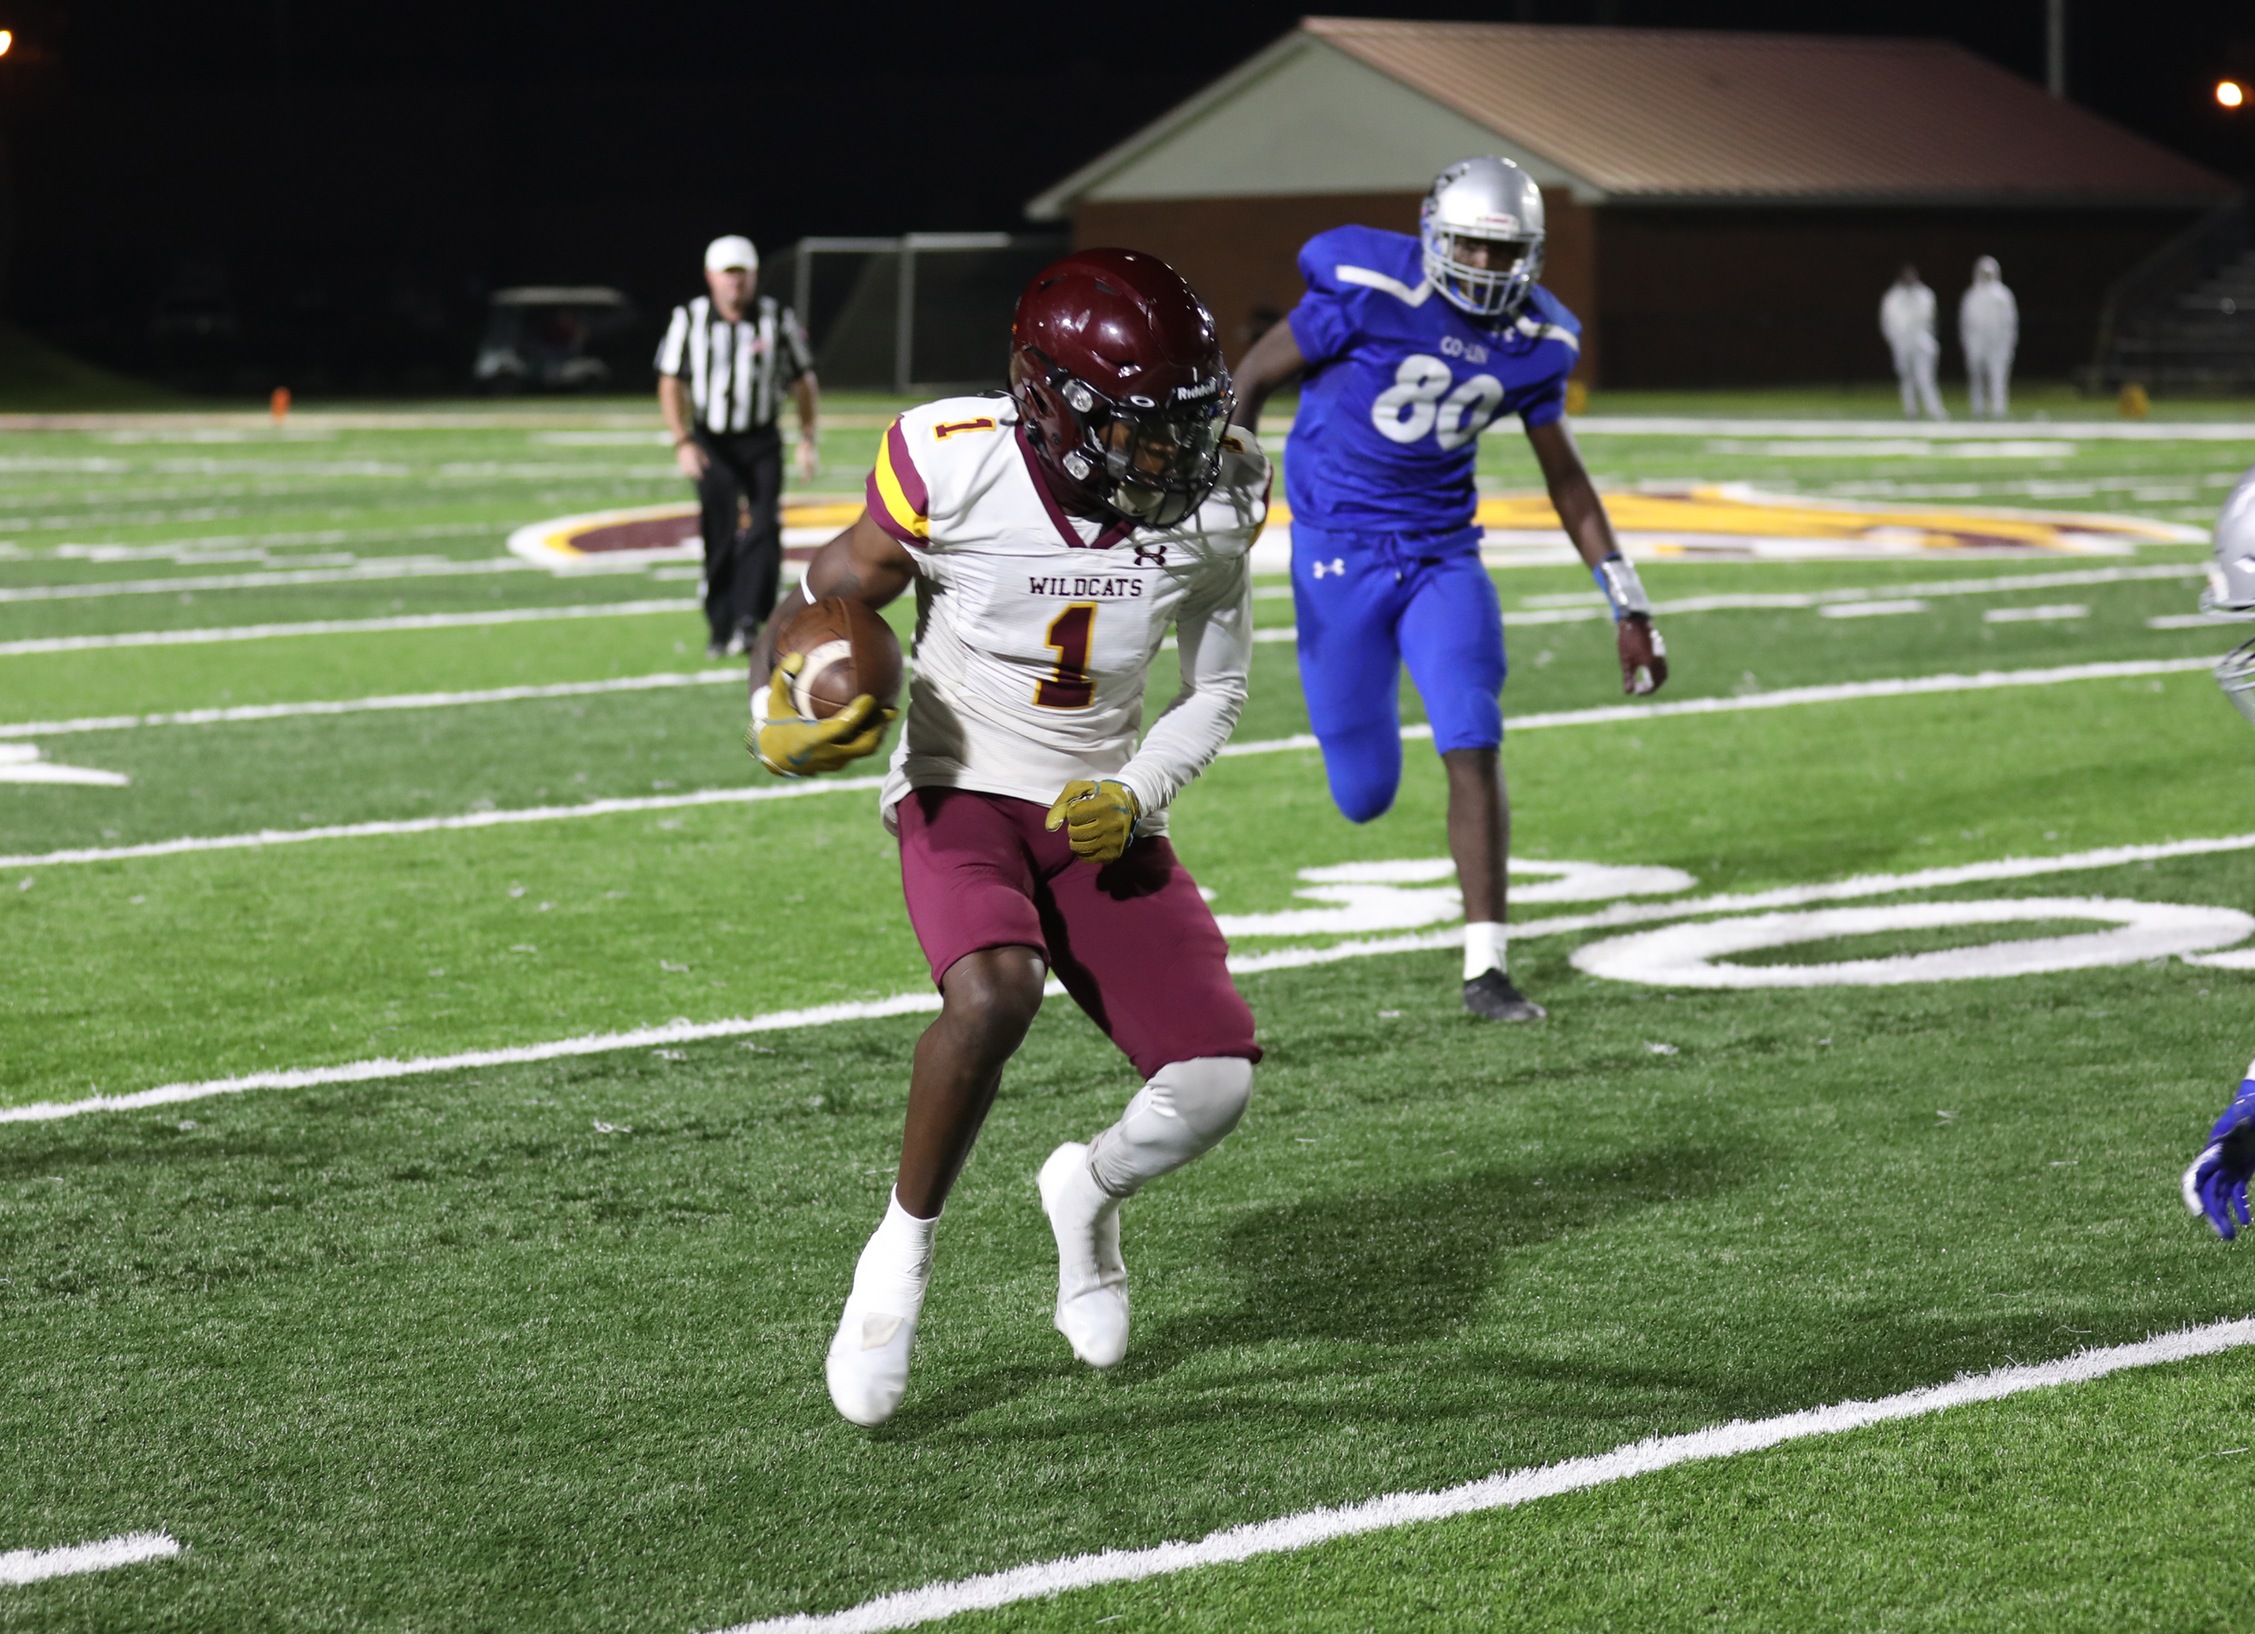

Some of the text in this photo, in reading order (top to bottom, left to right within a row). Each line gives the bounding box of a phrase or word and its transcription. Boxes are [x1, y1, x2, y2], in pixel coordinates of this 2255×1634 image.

[932, 415, 997, 443] 1
[1371, 353, 1505, 452] 80
[1028, 576, 1144, 597] WILDCATS
[1032, 600, 1098, 709] 1
